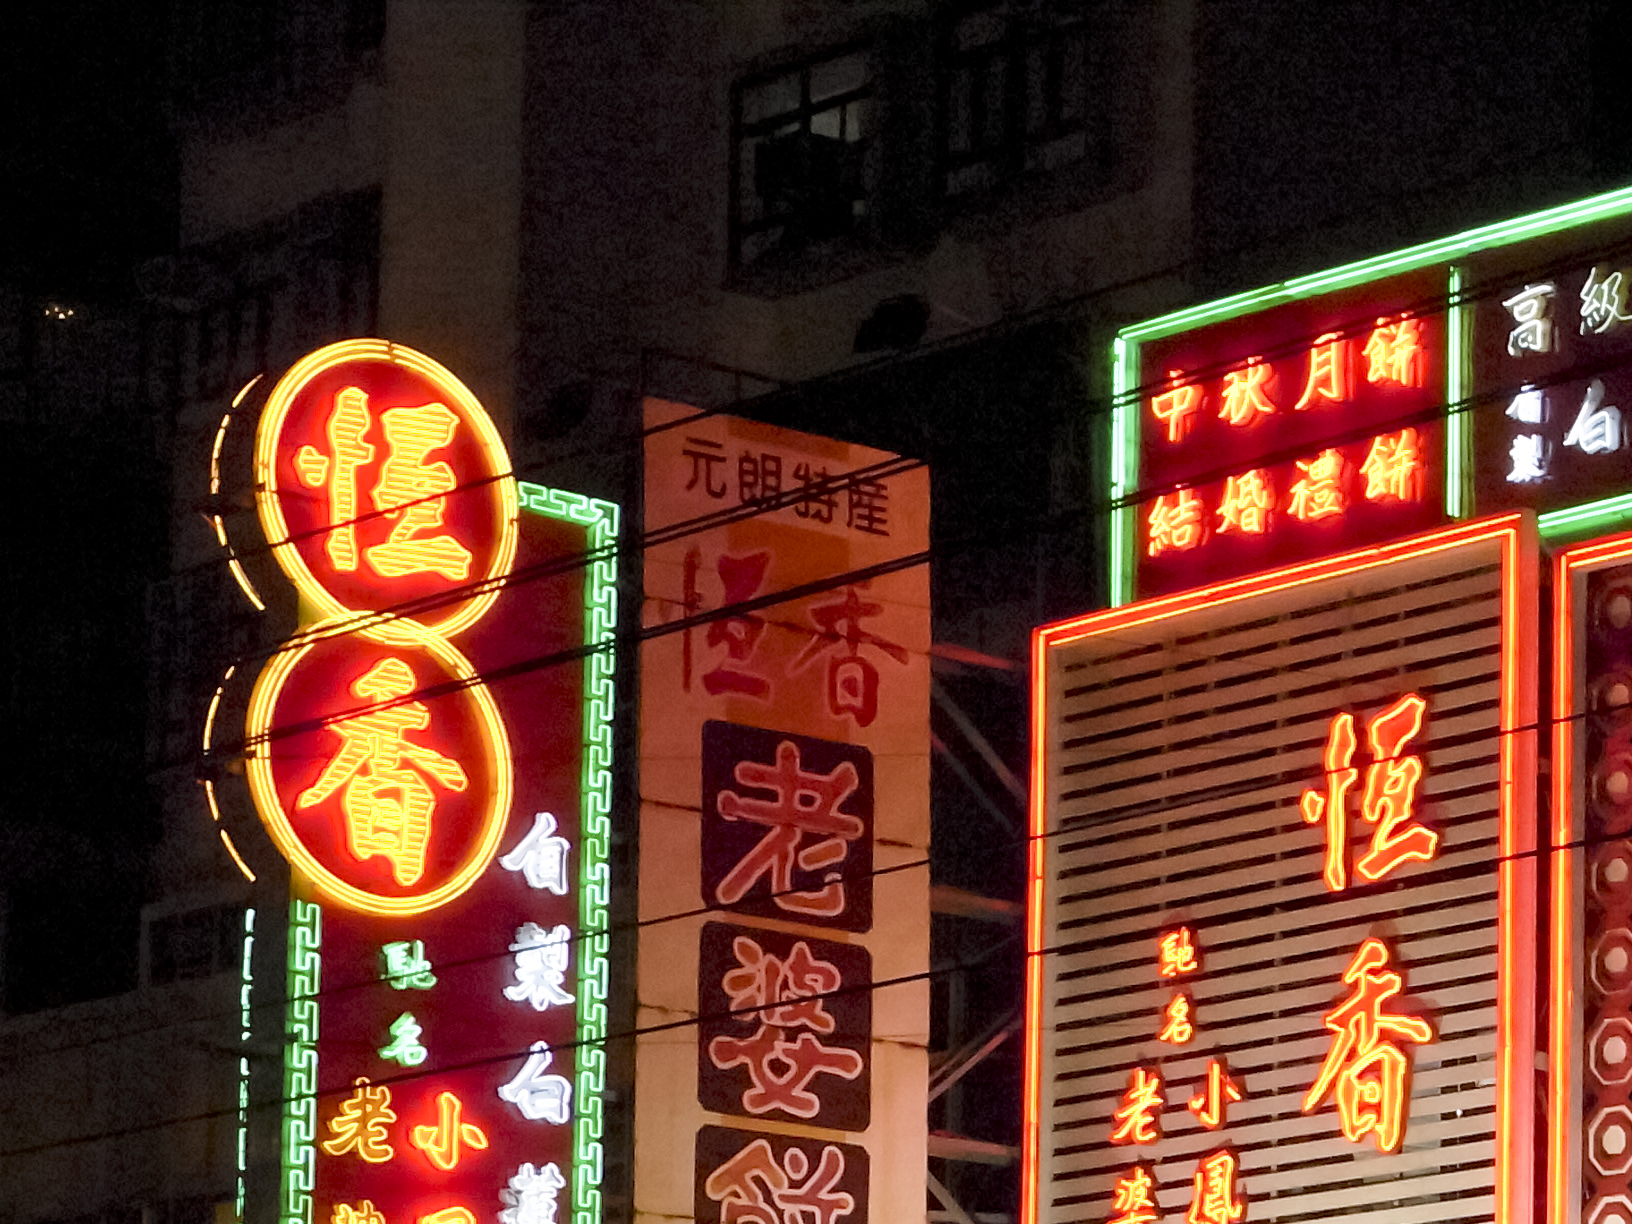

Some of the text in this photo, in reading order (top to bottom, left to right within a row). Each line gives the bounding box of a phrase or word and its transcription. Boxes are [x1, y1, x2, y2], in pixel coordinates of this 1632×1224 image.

[1151, 311, 1423, 442] 中秋月餅
[1148, 427, 1421, 558] 結婚禮餅
